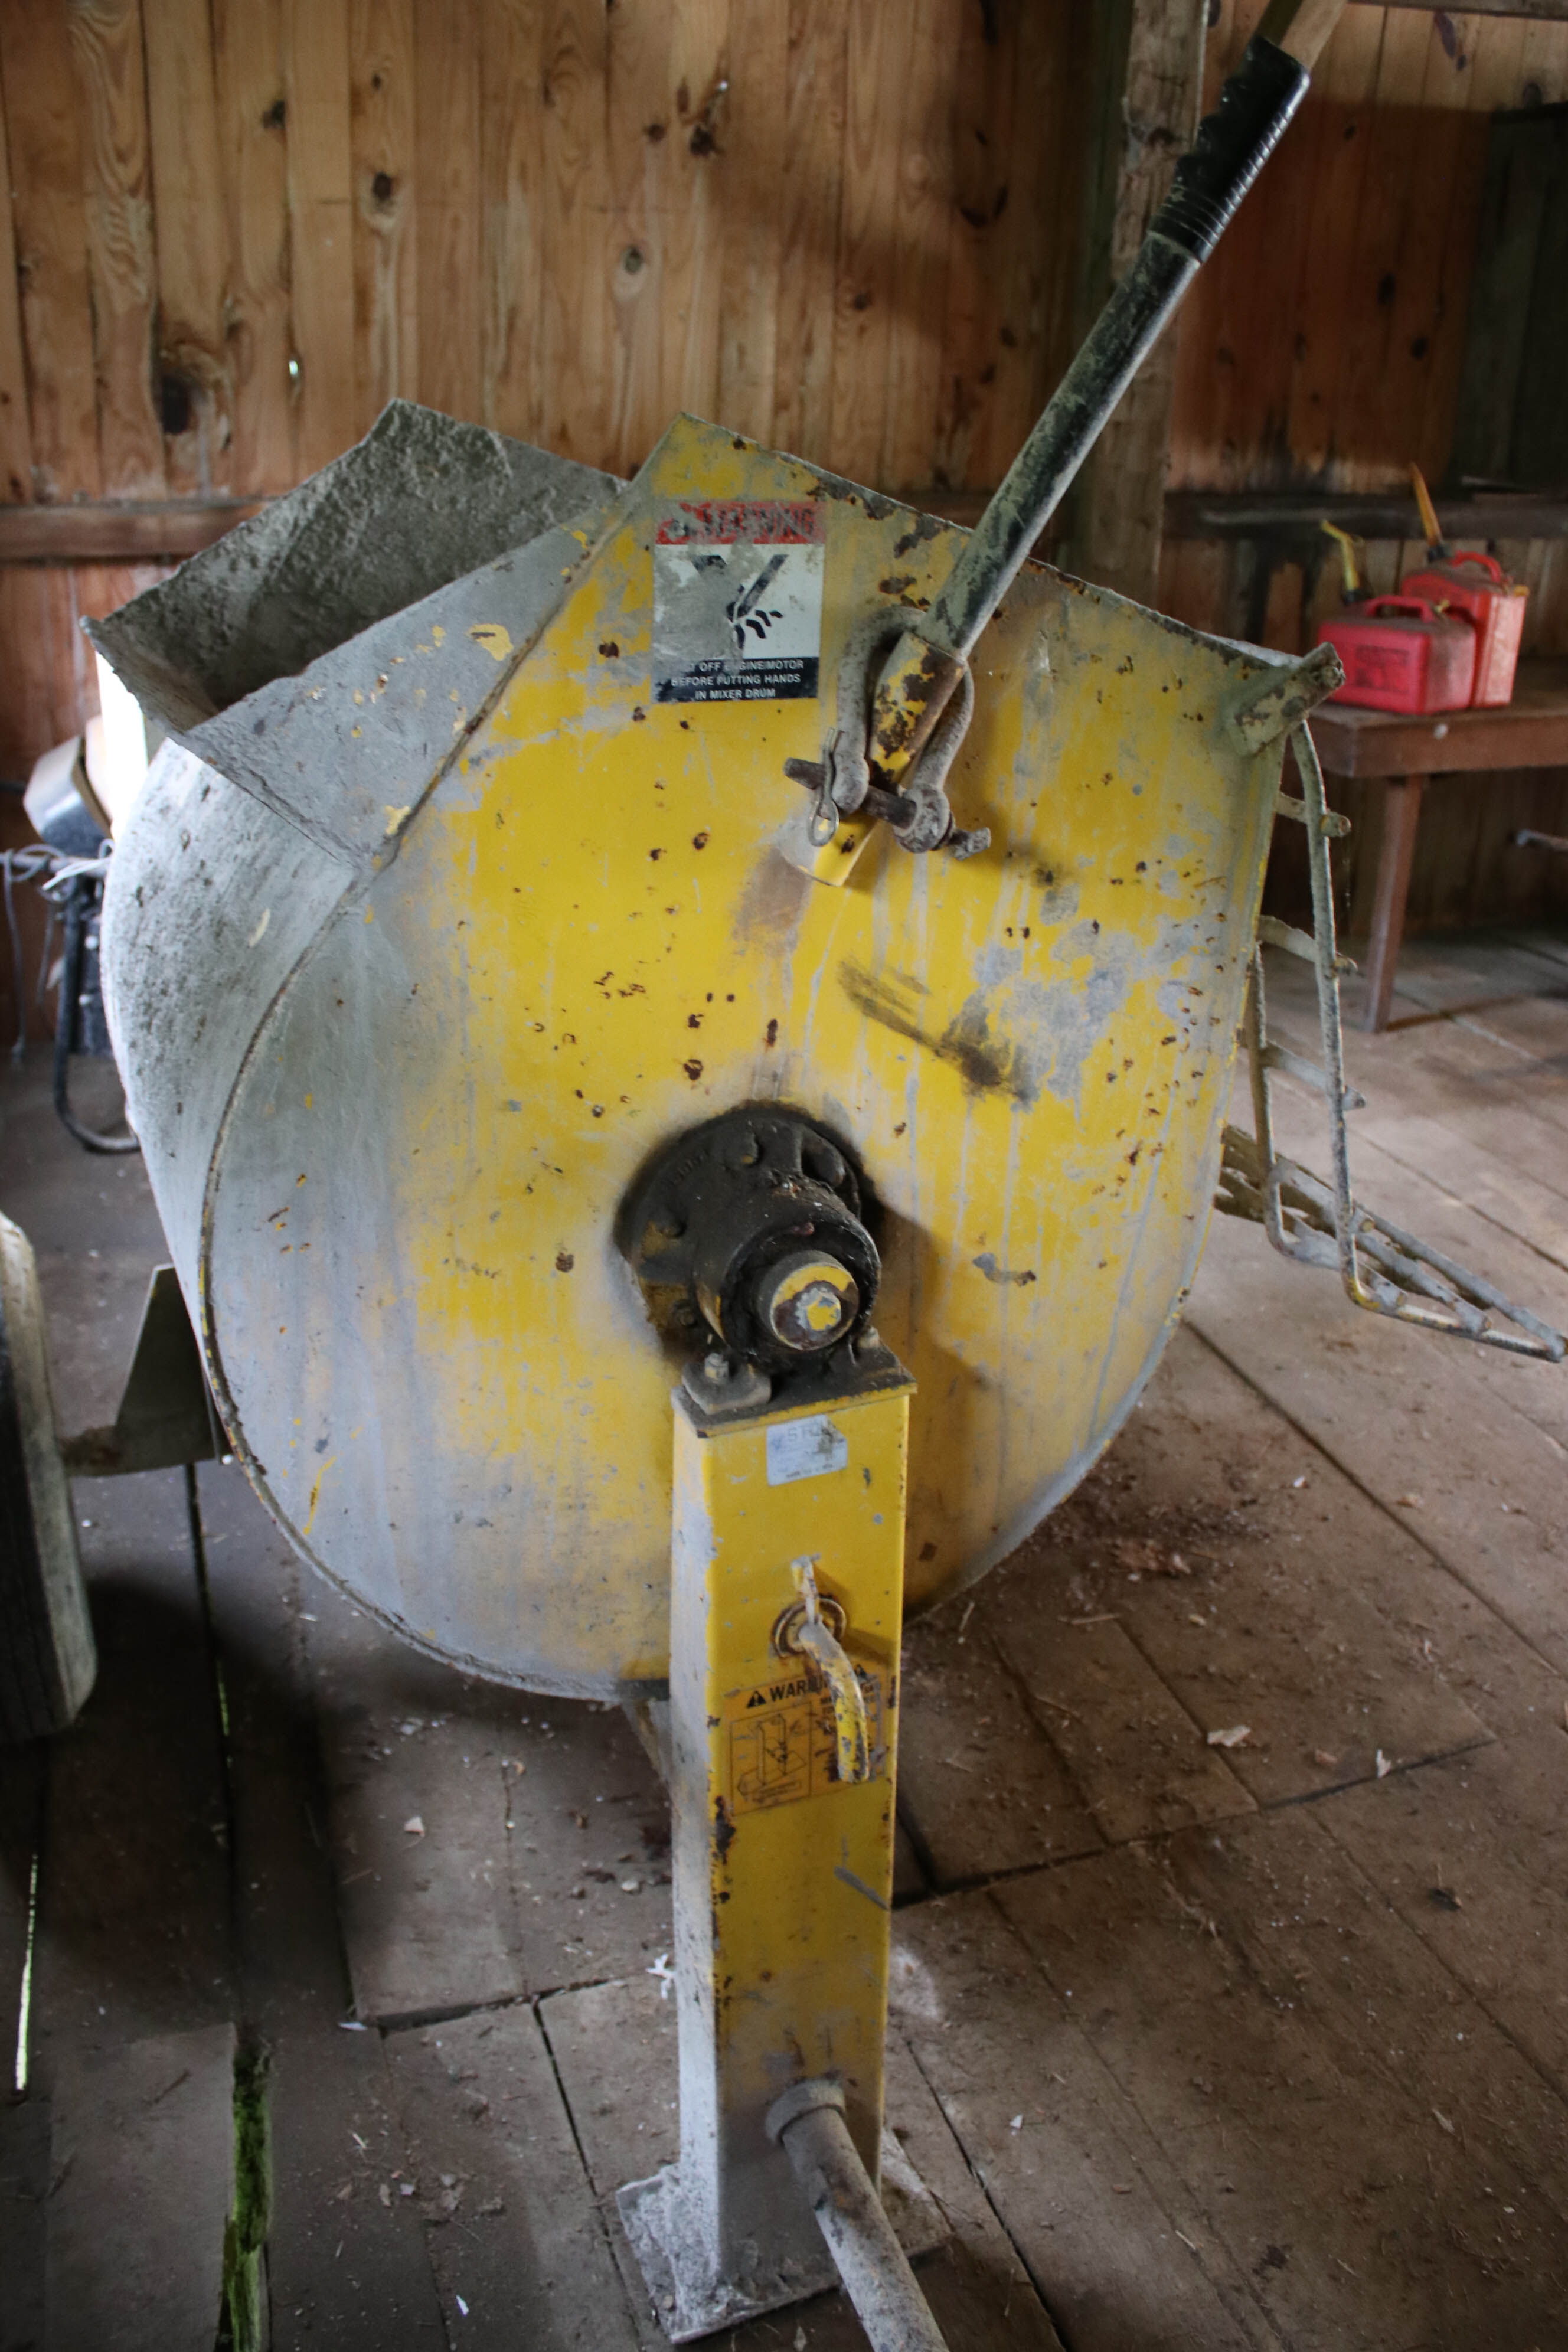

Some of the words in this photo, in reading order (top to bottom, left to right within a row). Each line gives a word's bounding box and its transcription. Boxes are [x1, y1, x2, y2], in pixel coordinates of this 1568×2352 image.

[698, 661, 721, 672] OFF
[671, 675, 714, 687] BEFORE
[717, 674, 761, 685] PUTTING
[764, 673, 801, 684] HANDS
[695, 690, 707, 700] IN
[710, 689, 743, 700] MIXER
[745, 688, 776, 698] DRUM
